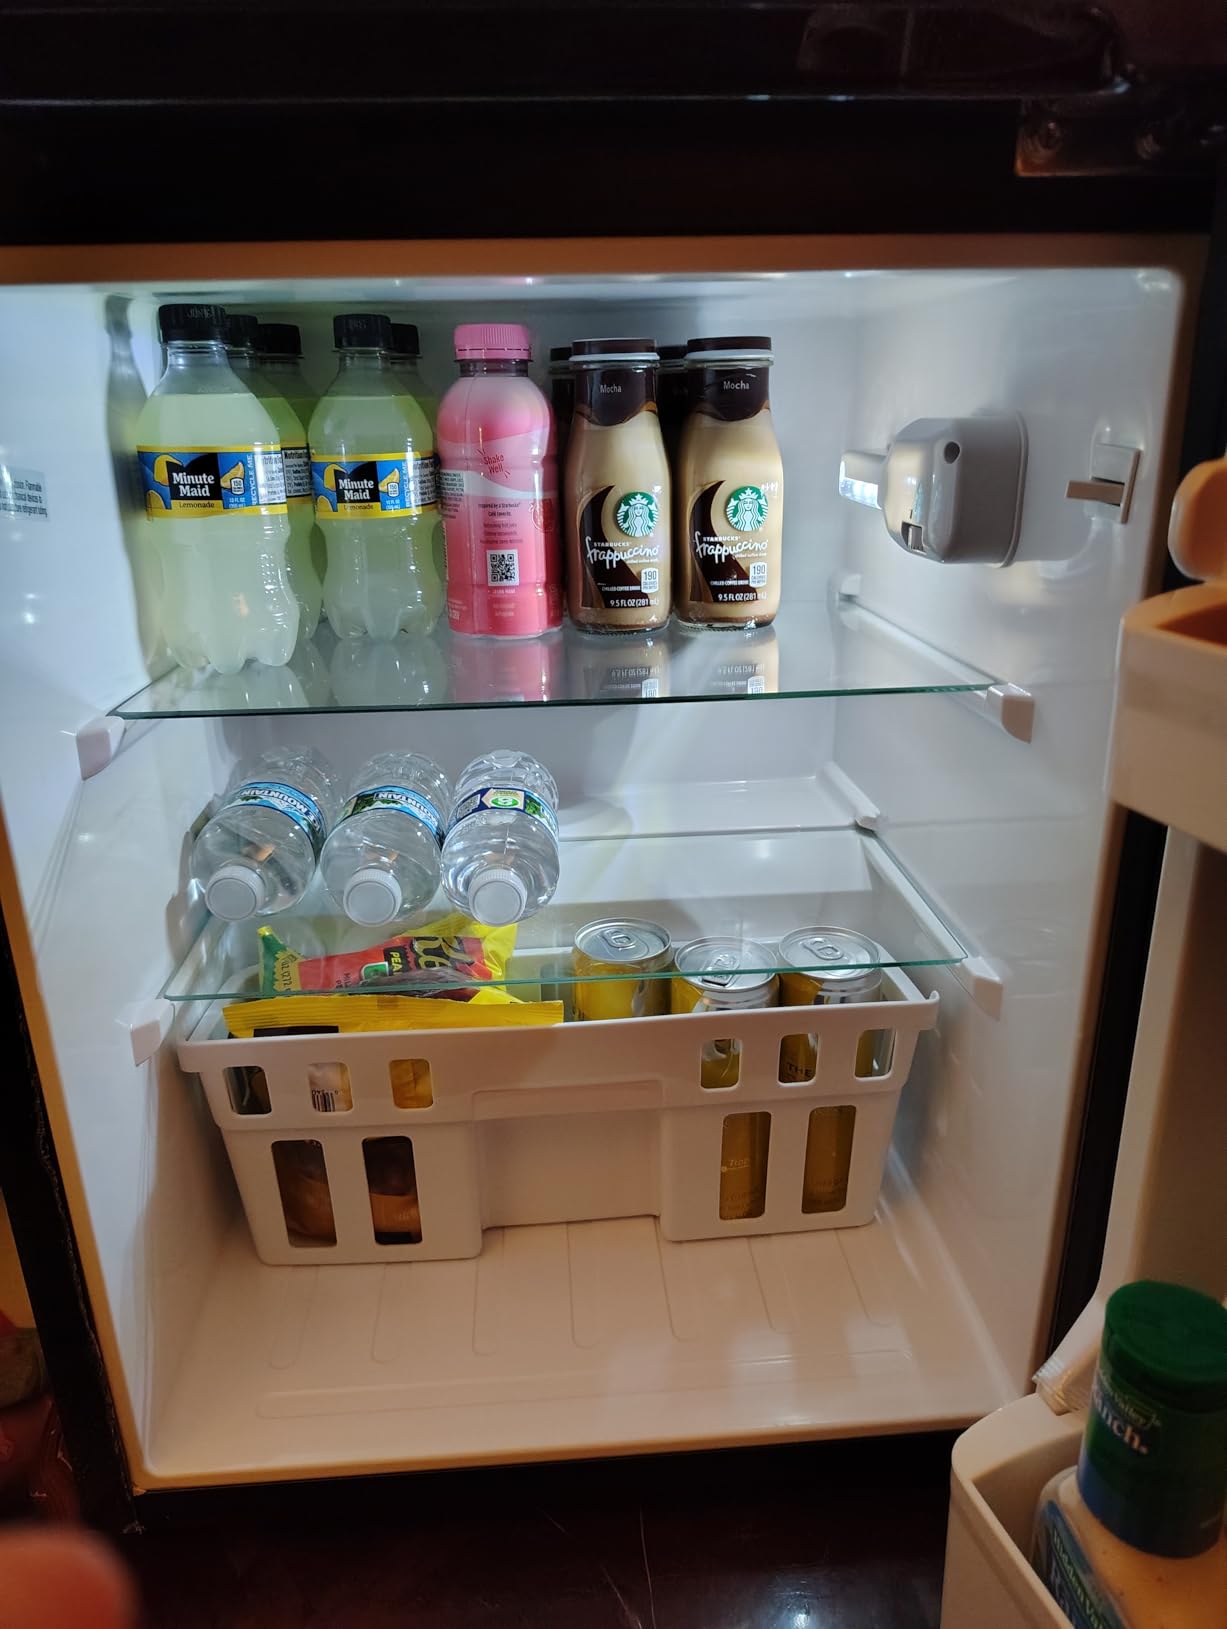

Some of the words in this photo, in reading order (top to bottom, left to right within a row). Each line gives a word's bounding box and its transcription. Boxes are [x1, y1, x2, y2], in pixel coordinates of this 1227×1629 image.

[600, 384, 622, 394] Mocha
[723, 380, 750, 390] Mocha
[483, 454, 504, 465] Shake
[488, 464, 504, 475] Well
[172, 472, 215, 484] Minute
[338, 479, 374, 489] Minute
[178, 485, 211, 497] Maid
[344, 490, 370, 500] Maid
[644, 570, 657, 580] 190
[753, 565, 766, 575] 190
[744, 593, 756, 601] (281
[636, 598, 649, 607] (281
[240, 790, 308, 812] MOUNTAIN
[390, 952, 403, 973] PEA
